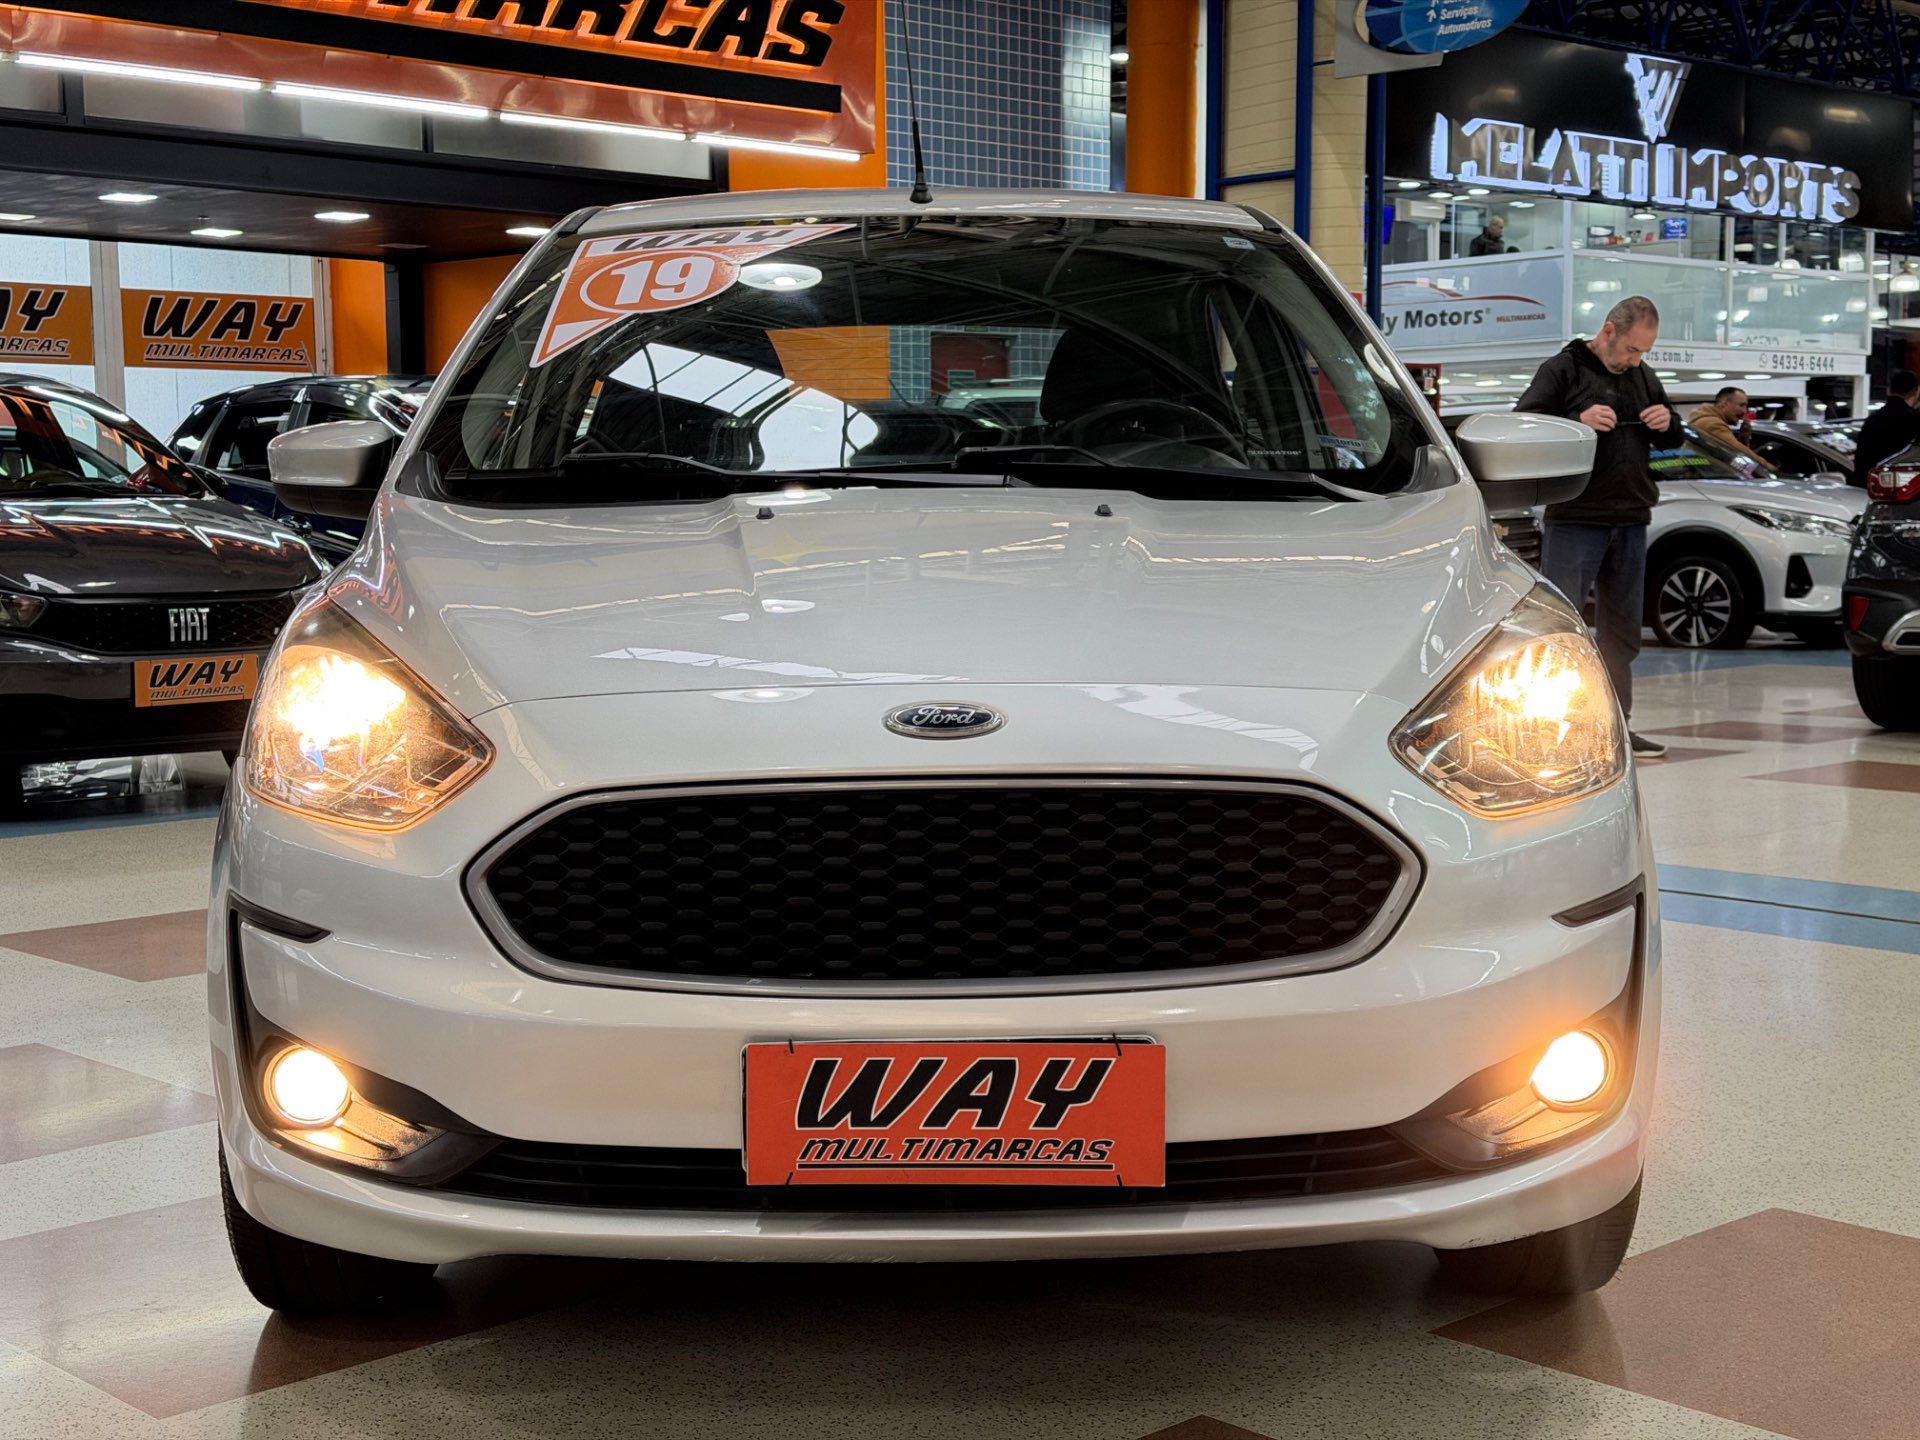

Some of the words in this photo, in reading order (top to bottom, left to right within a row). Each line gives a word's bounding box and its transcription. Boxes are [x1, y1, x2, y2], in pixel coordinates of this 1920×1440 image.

[1440, 6, 1479, 20] Serviços
[1437, 18, 1493, 36] Automotivos
[613, 229, 793, 252] WAY
[610, 256, 716, 306] 19
[141, 295, 306, 343] WAY
[1496, 313, 1546, 323] MULTIMARCAS
[144, 343, 308, 362] MULTIMARCAS
[1772, 354, 1834, 371] 94334-6444
[168, 608, 210, 642] FIAT
[149, 659, 245, 689] WAY
[150, 685, 244, 699] MULTIMARCAS
[912, 706, 975, 726] Ford
[795, 1057, 1117, 1130] WAY
[796, 1137, 1115, 1162] MULTIMARCAS
